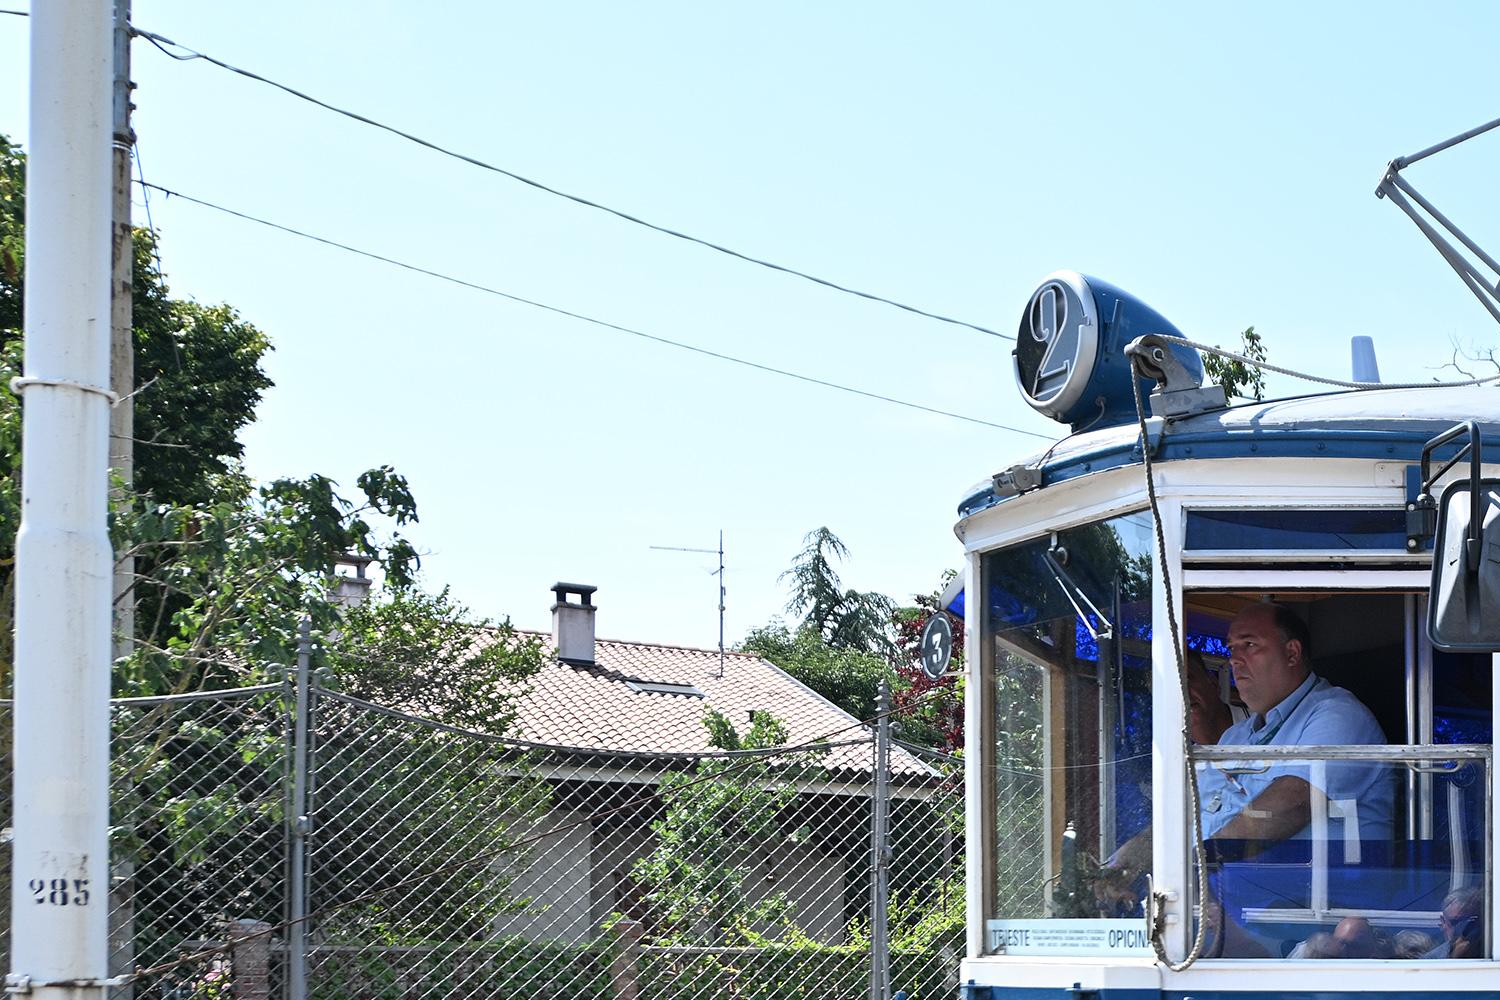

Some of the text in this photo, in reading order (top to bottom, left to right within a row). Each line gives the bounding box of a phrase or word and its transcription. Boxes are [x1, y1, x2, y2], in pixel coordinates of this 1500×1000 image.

[1030, 281, 1071, 399] 2
[931, 632, 943, 664] 3
[28, 878, 89, 906] 285
[991, 929, 1031, 947] TRIESTE
